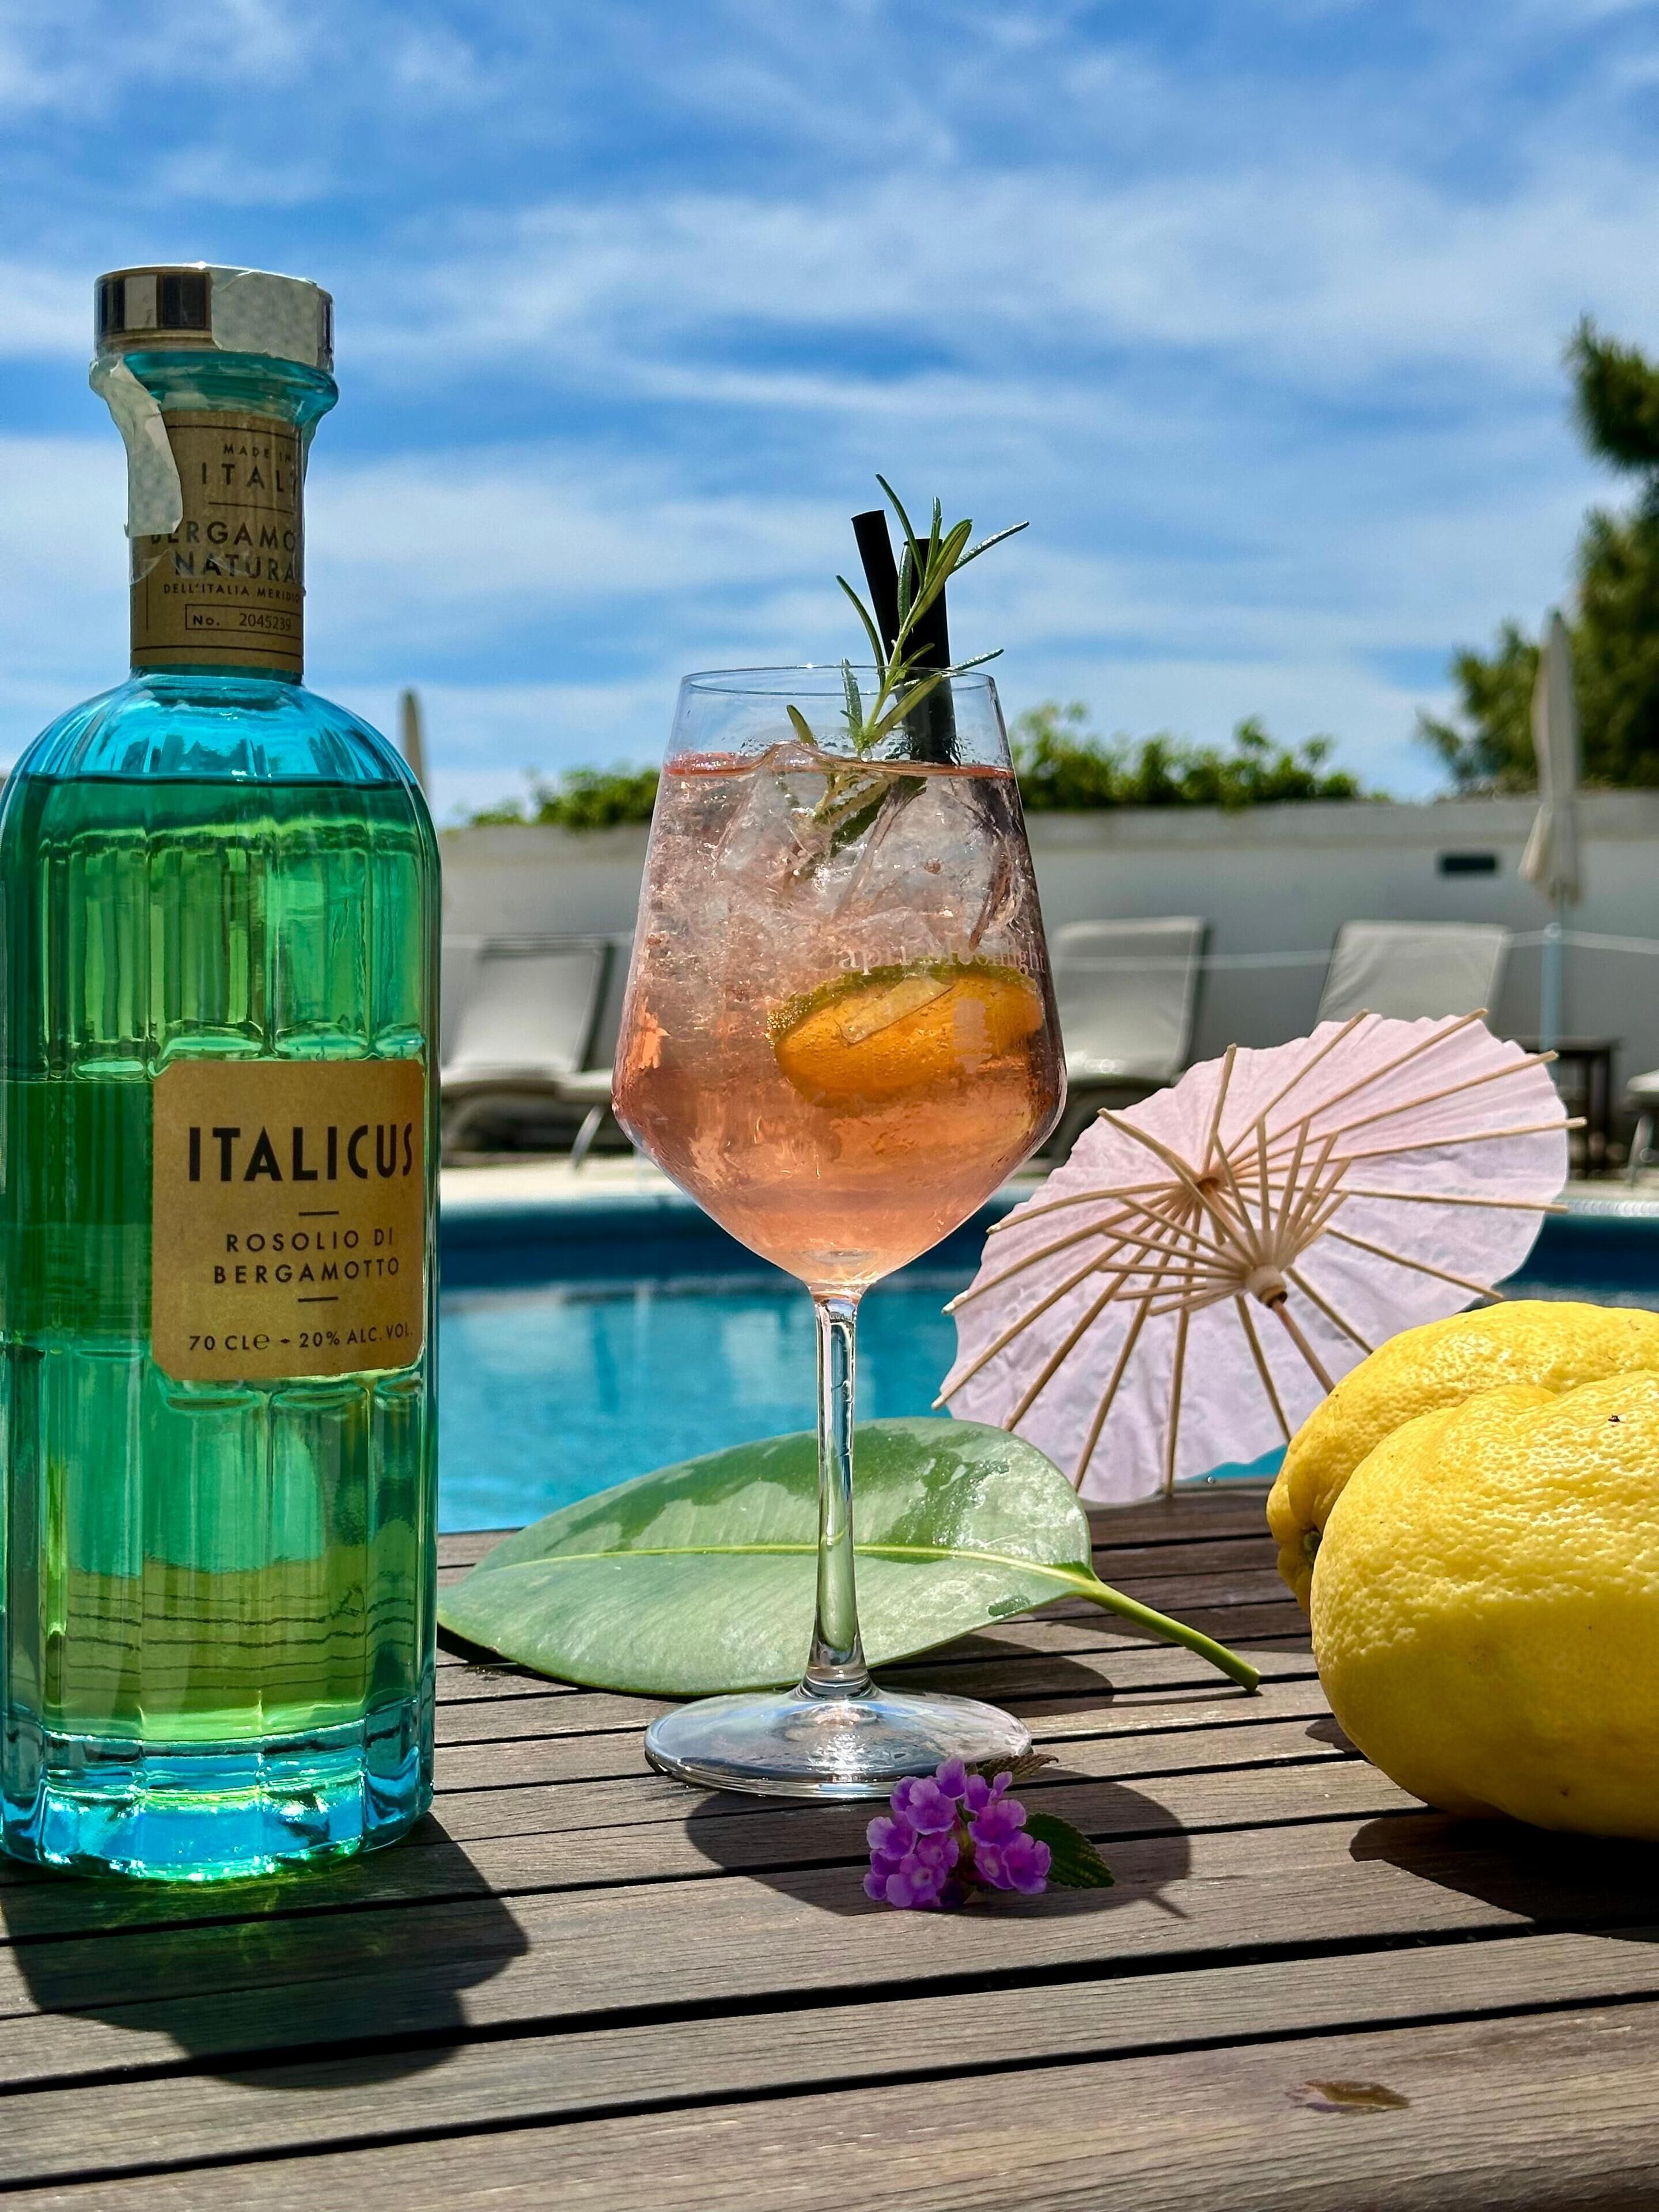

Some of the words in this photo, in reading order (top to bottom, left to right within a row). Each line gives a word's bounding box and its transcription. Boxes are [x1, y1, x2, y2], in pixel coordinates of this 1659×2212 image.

[223, 443, 270, 459] MADE
[175, 551, 300, 585] NATURA
[164, 583, 249, 596] DELL'ITALIA
[193, 615, 220, 626] No.
[238, 612, 291, 632] 2045239
[188, 1123, 412, 1182] ITALICUS
[226, 1229, 359, 1252] ROSOLIO
[374, 1227, 393, 1247] DI
[214, 1256, 400, 1285] BERGAMOTTO
[189, 1335, 215, 1351] 70
[299, 1330, 340, 1349] 20%
[347, 1327, 382, 1344] ALC.
[386, 1322, 413, 1340] VOL.
